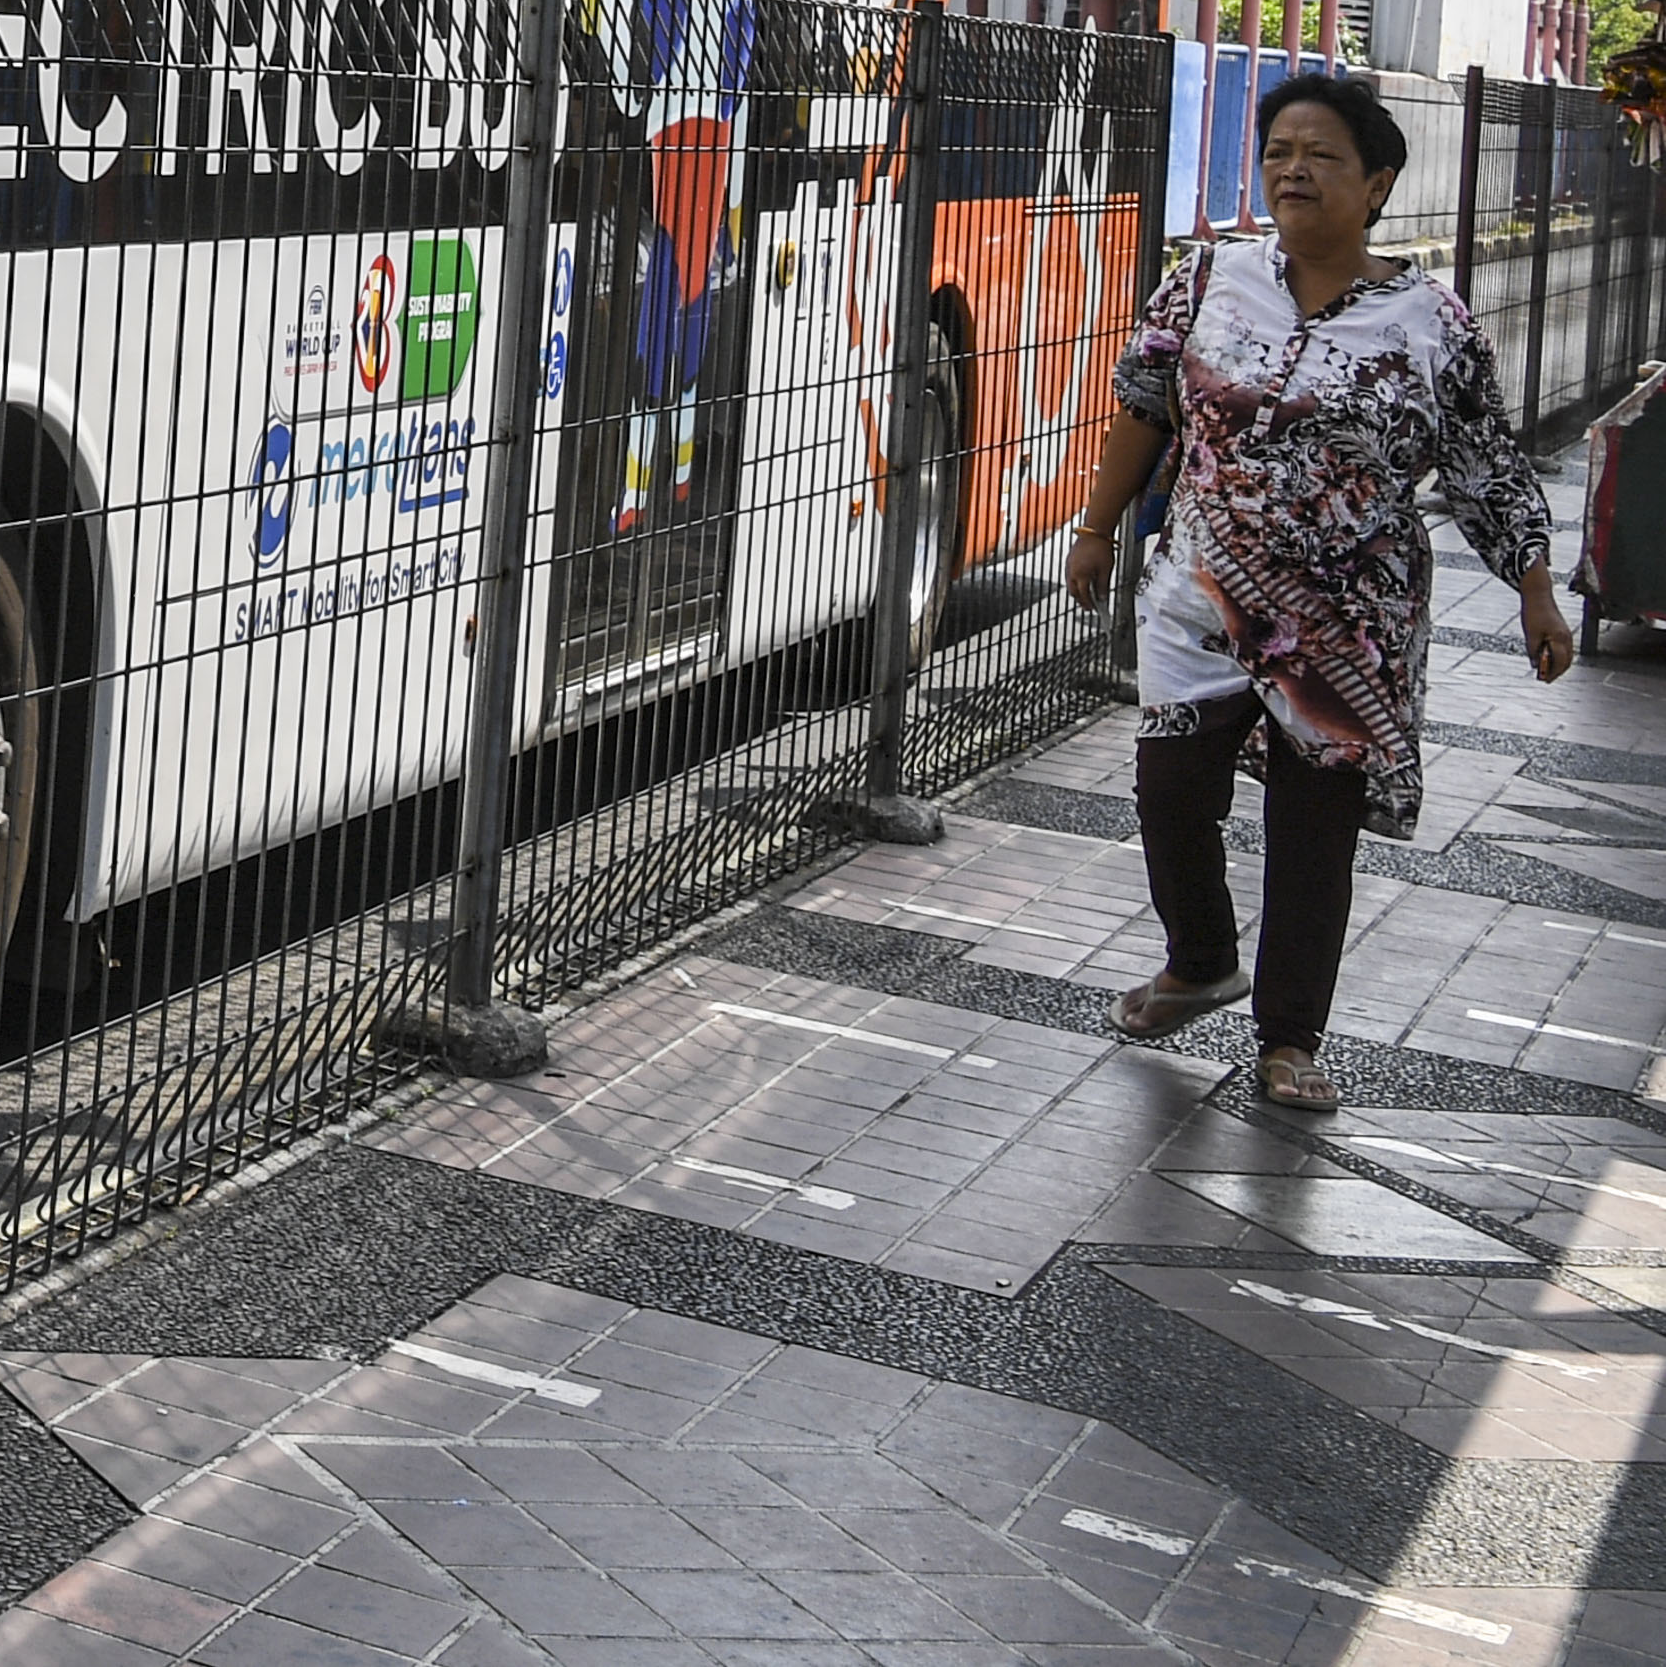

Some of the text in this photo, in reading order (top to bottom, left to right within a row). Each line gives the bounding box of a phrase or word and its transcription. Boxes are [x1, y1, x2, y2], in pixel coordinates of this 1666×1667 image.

[285, 319, 341, 335] BAKETBL
[417, 319, 457, 343] PRGRA
[285, 335, 321, 359] WRLD
[300, 572, 363, 624] Moblity
[364, 569, 387, 606] for
[390, 551, 436, 597] Smart
